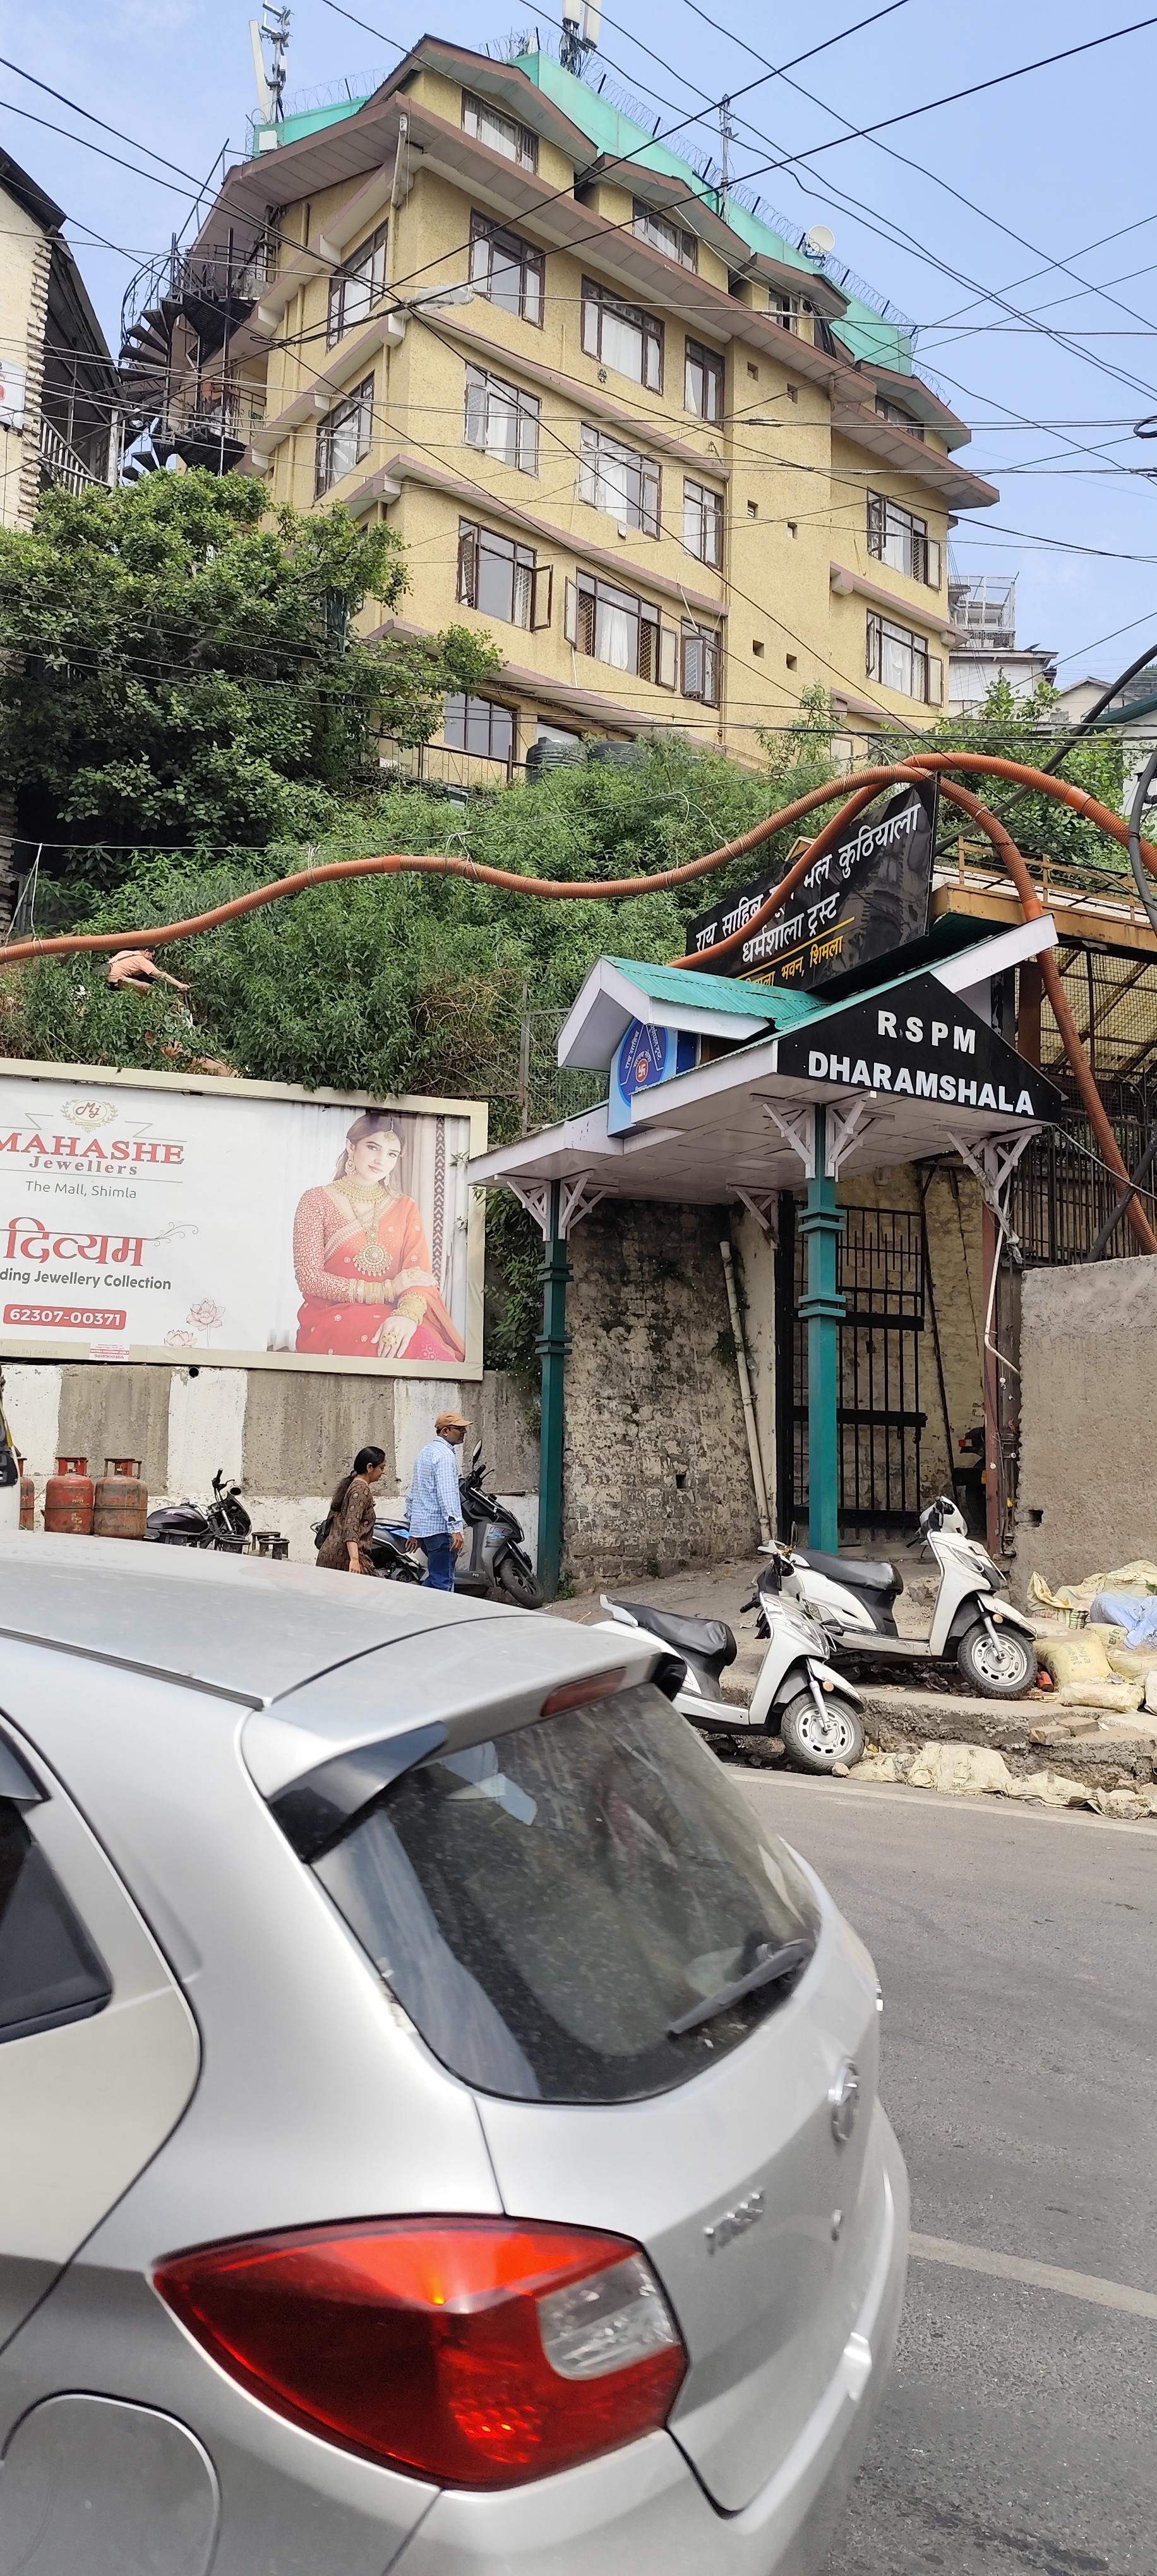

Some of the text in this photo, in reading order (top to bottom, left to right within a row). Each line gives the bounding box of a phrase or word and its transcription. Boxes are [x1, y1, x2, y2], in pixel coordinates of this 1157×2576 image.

[696, 922, 718, 952] राय
[722, 893, 764, 938] साहिब
[838, 803, 922, 879] कुठियाला
[743, 913, 805, 963] धर्मशाला
[807, 891, 840, 937] ट्रस्ट
[781, 956, 805, 980] भवन,
[810, 936, 844, 968] शिमला
[808, 1050, 1034, 1116] DHARAMSHALA
[0, 1132, 184, 1165] MAHASHE
[29, 1155, 138, 1176] Jewellers
[25, 1181, 136, 1198] The Mall, Shimla
[3, 1217, 144, 1267] दिव्यम
[34, 1270, 101, 1289] Jewellery
[104, 1274, 171, 1290] Collection
[9, 1308, 121, 1326] 62307-00371
